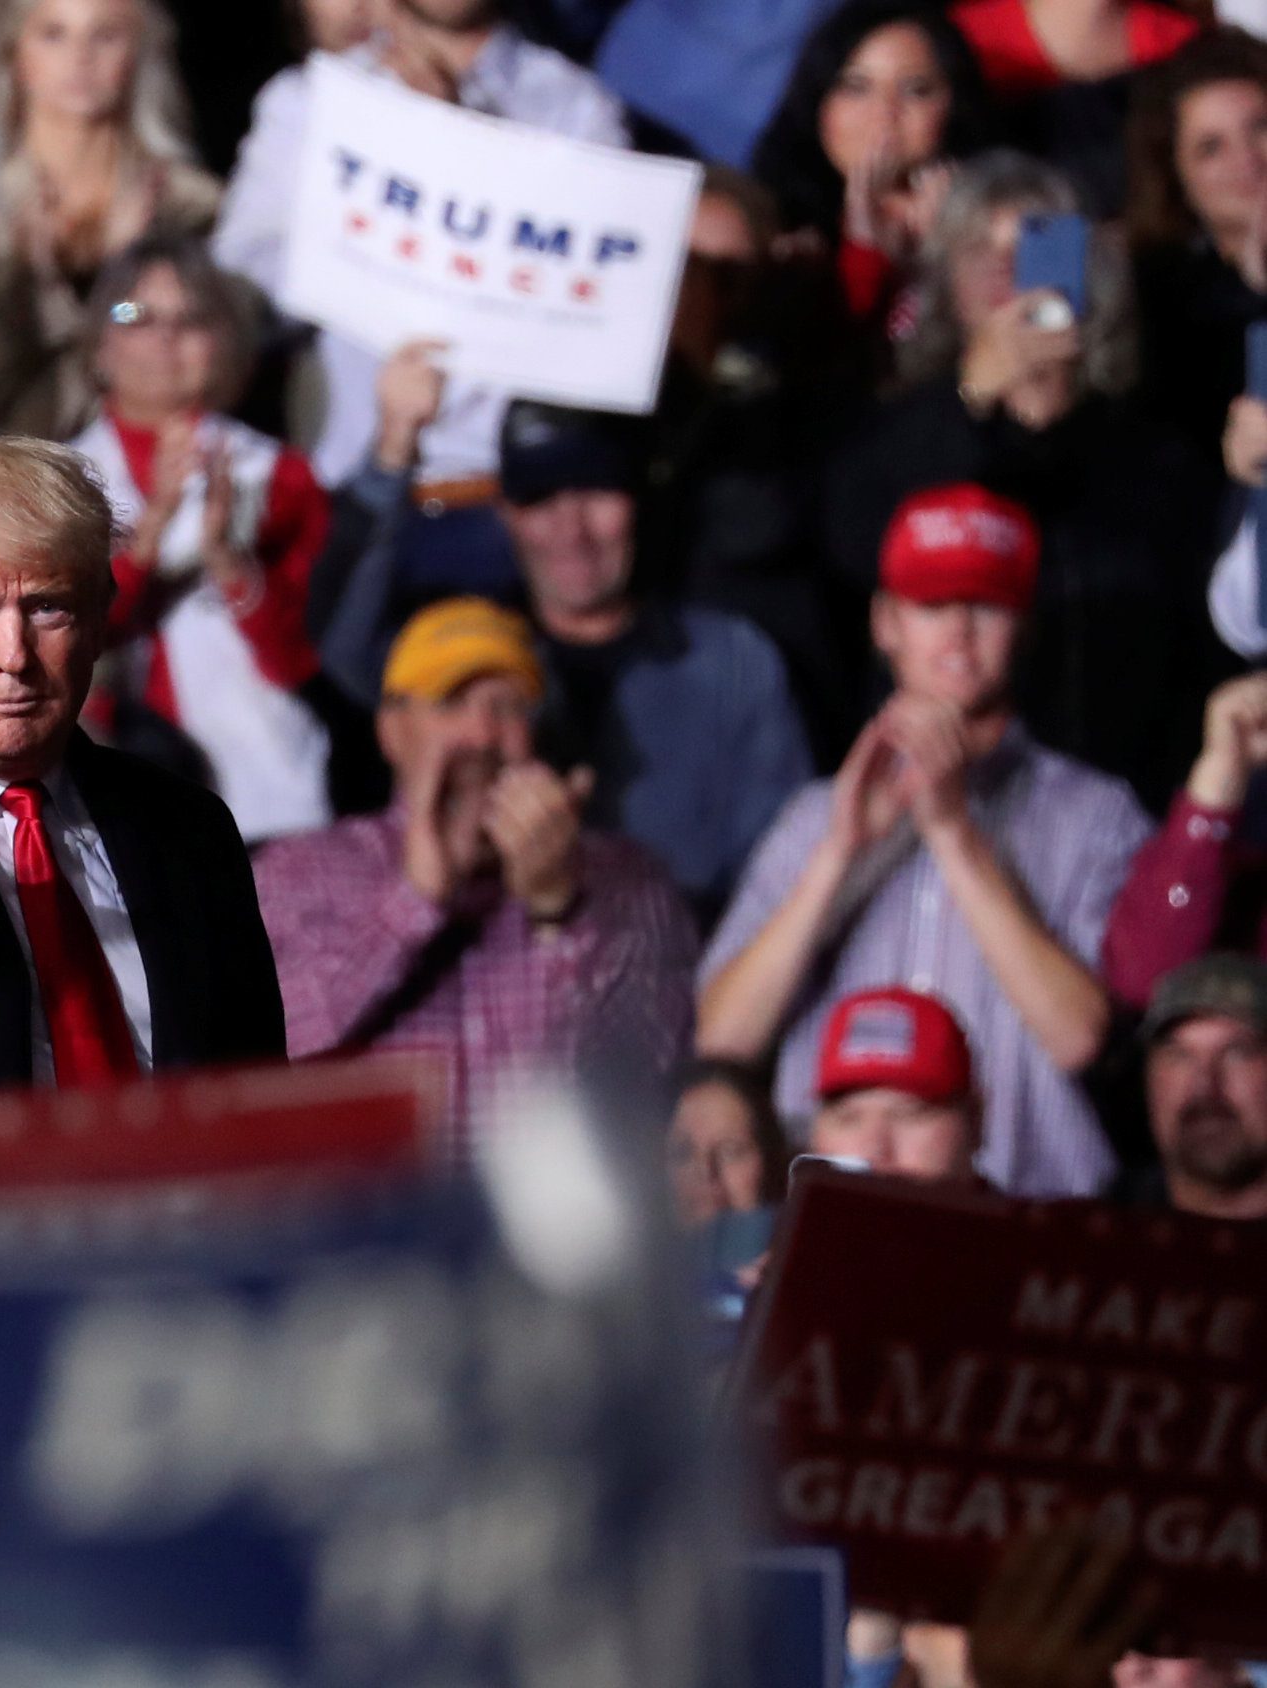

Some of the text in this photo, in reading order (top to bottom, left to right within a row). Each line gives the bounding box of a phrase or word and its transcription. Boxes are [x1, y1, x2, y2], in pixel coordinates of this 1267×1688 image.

[332, 144, 642, 266] TRUMP
[1012, 1269, 1257, 1360] MAKE
[778, 1454, 1066, 1542] GREAT
